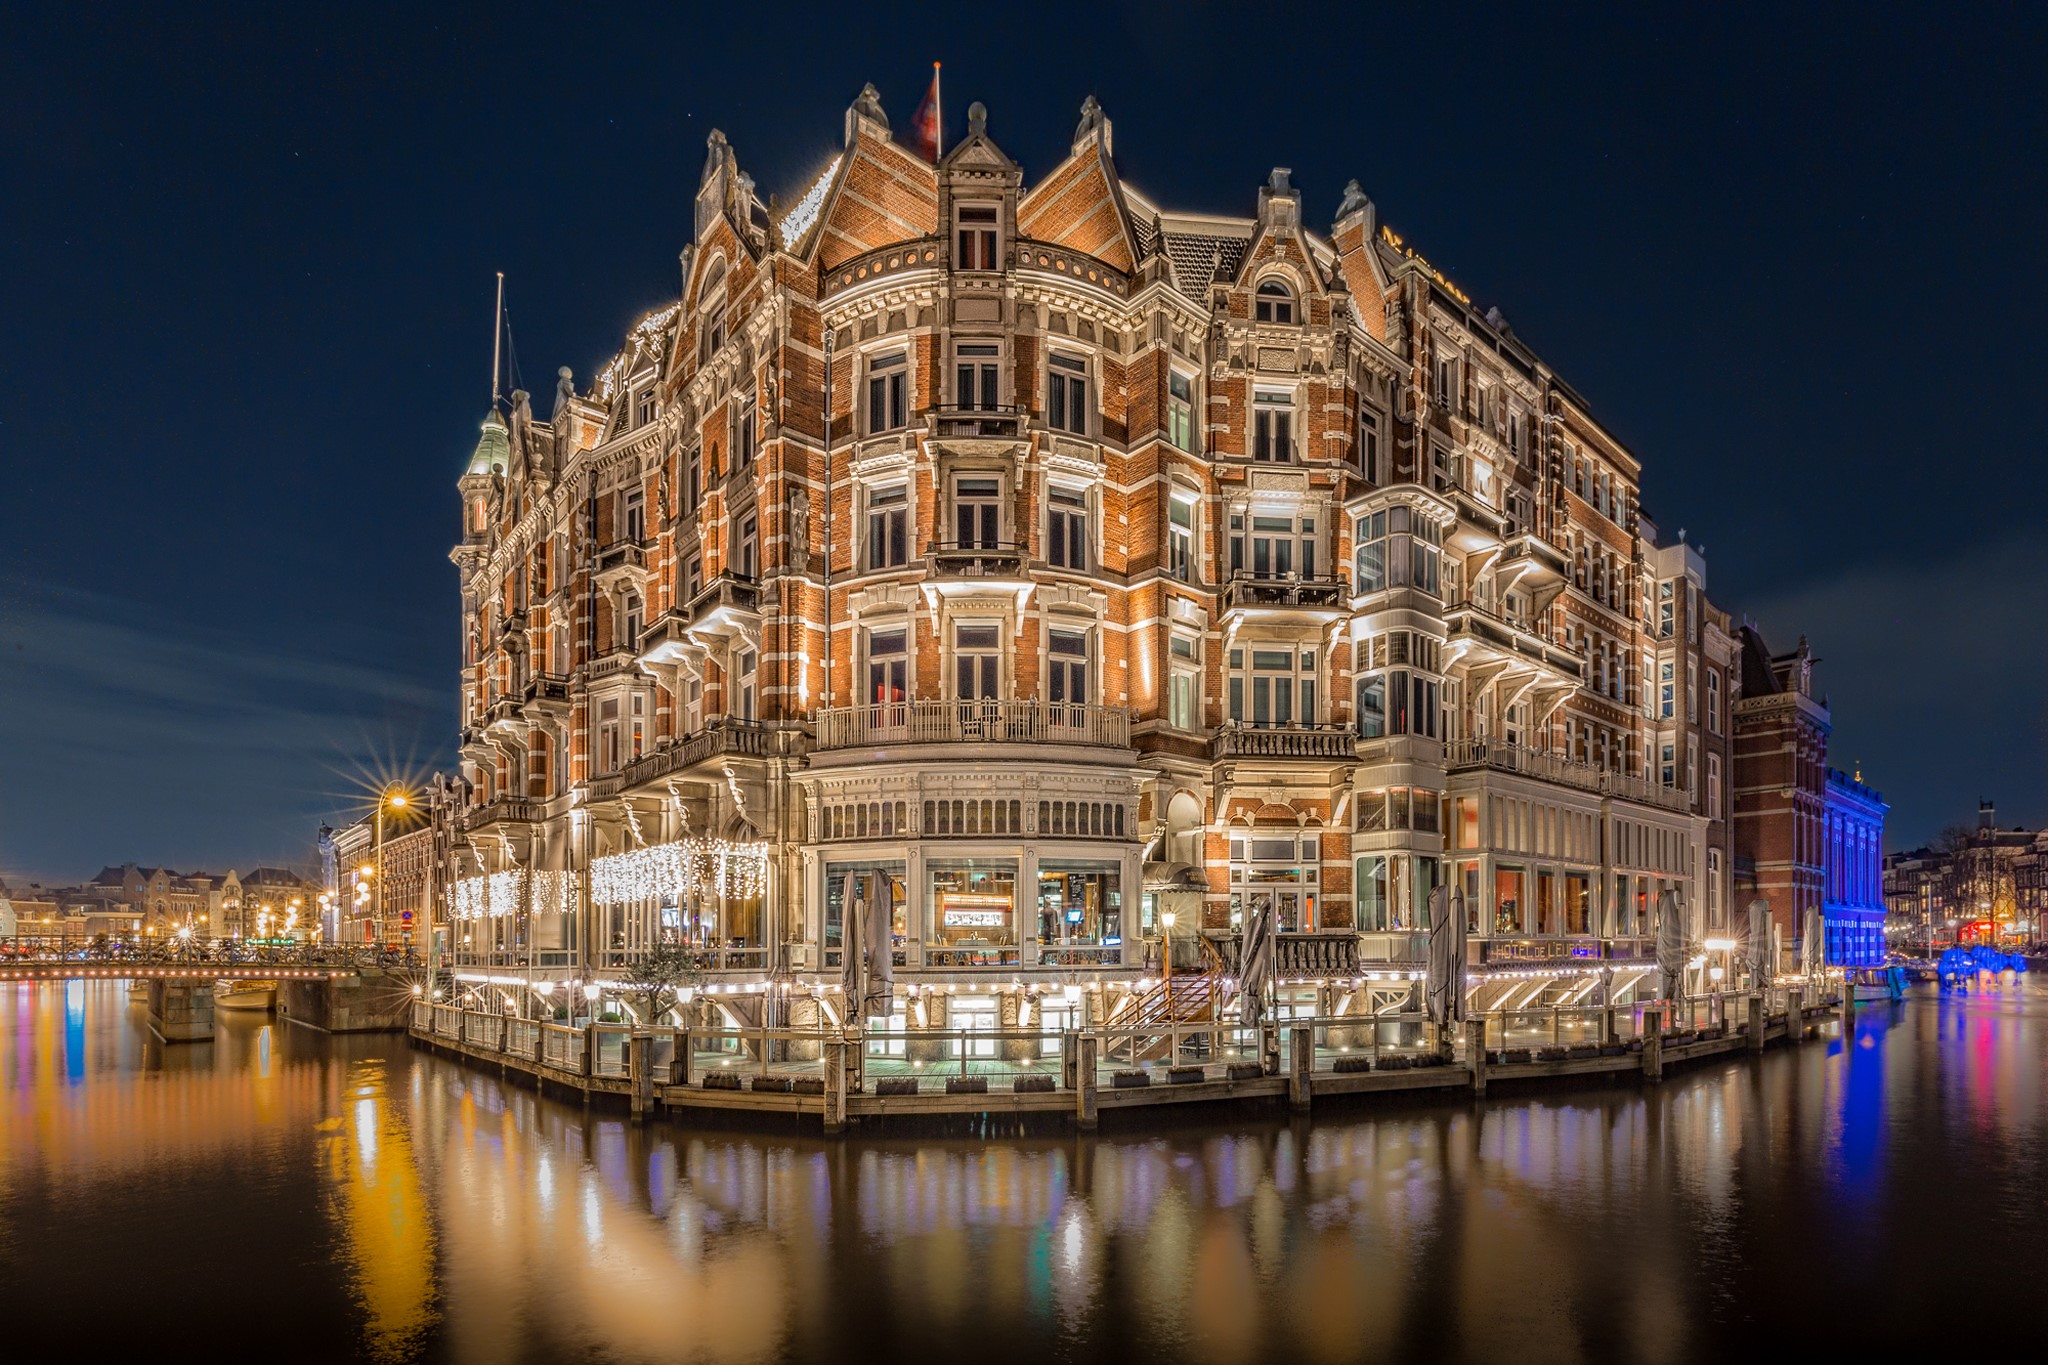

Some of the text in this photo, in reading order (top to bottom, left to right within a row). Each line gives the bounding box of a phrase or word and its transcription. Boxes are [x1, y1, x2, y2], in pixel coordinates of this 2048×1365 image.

[1496, 942, 1593, 959] HOTEL DE L'EUROPE
